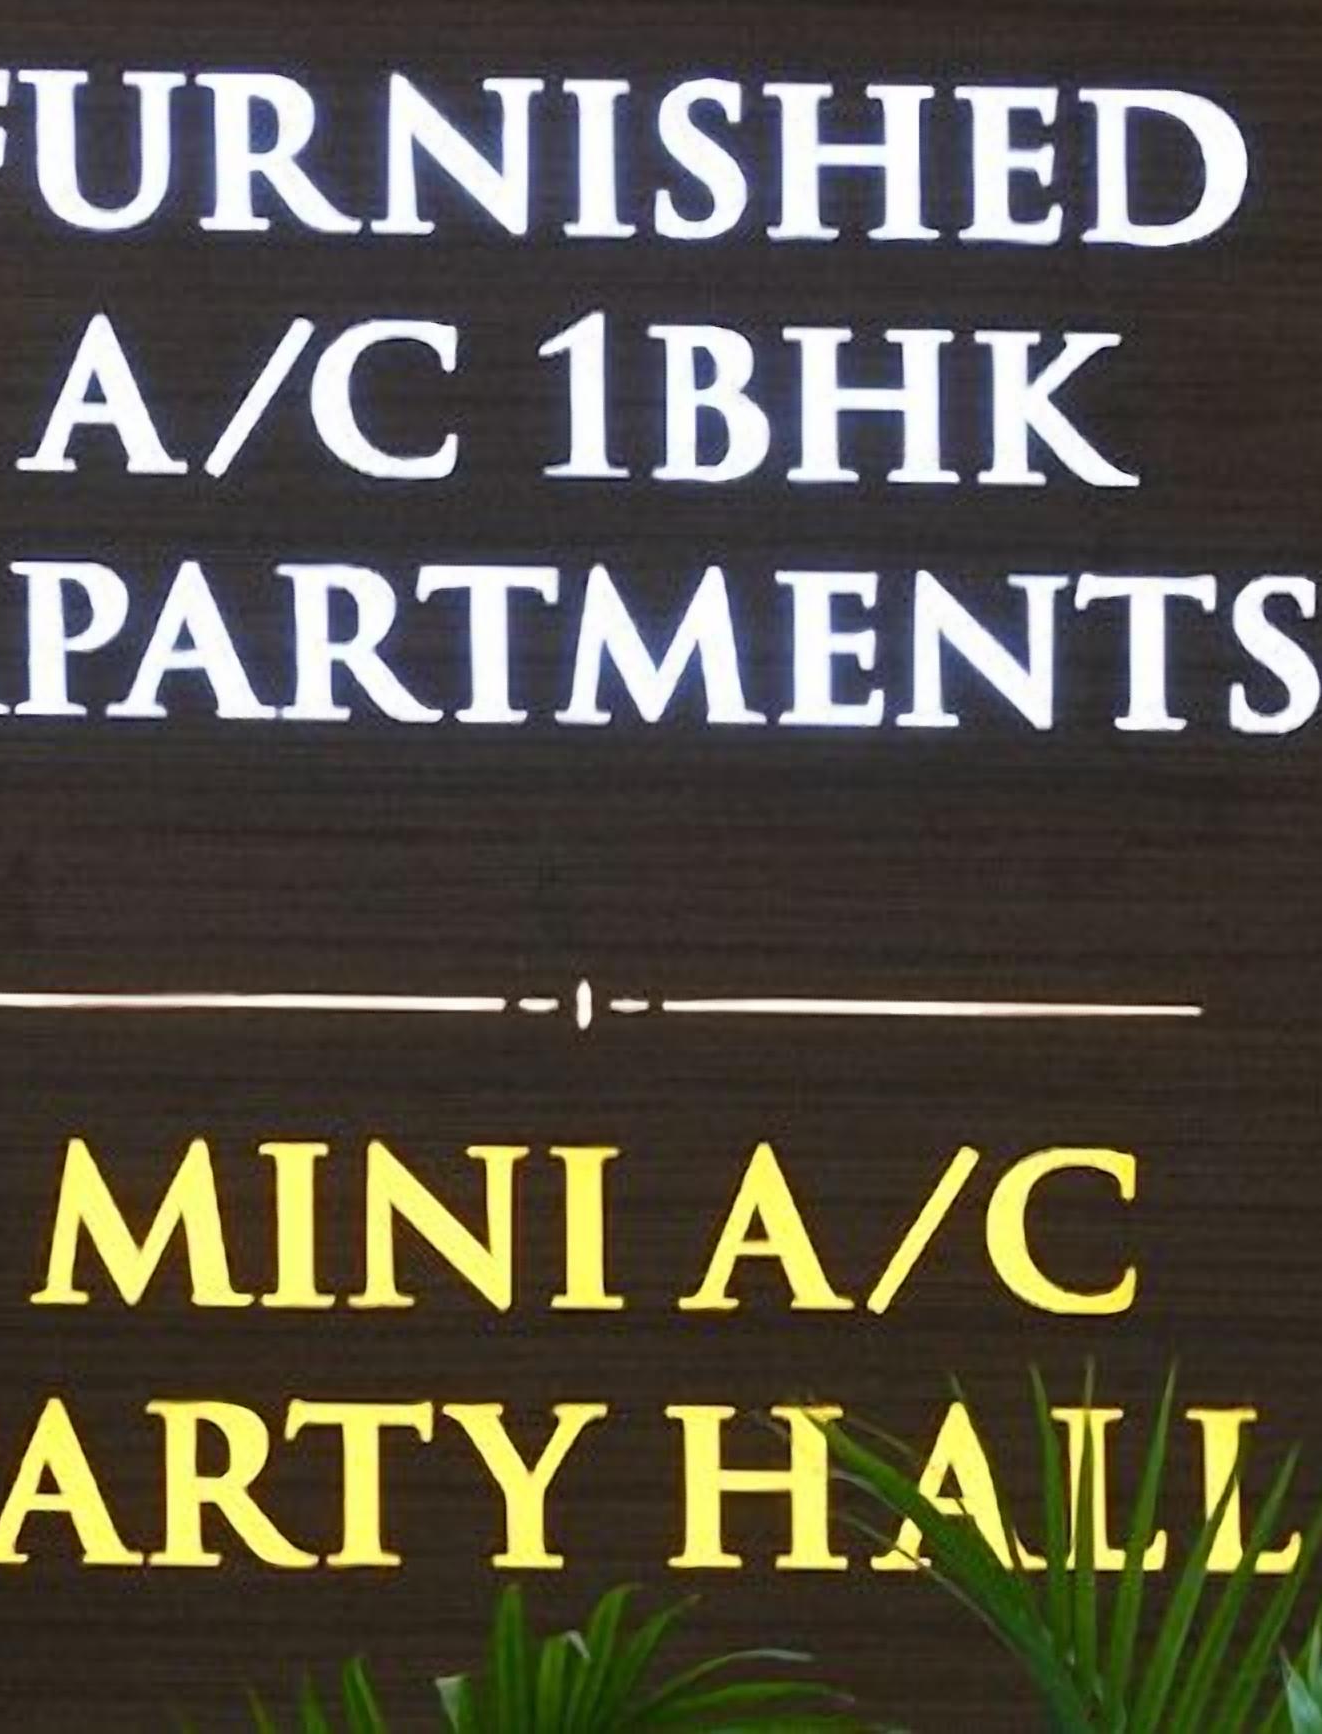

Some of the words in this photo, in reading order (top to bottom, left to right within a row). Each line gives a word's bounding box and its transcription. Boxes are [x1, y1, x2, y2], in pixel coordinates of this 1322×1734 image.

[16, 313, 459, 480] A/C
[538, 311, 1140, 487] 1BHK
[30, 1138, 624, 1311] MINI
[678, 1142, 1137, 1314] A/C
[665, 1401, 1303, 1573] HALL
